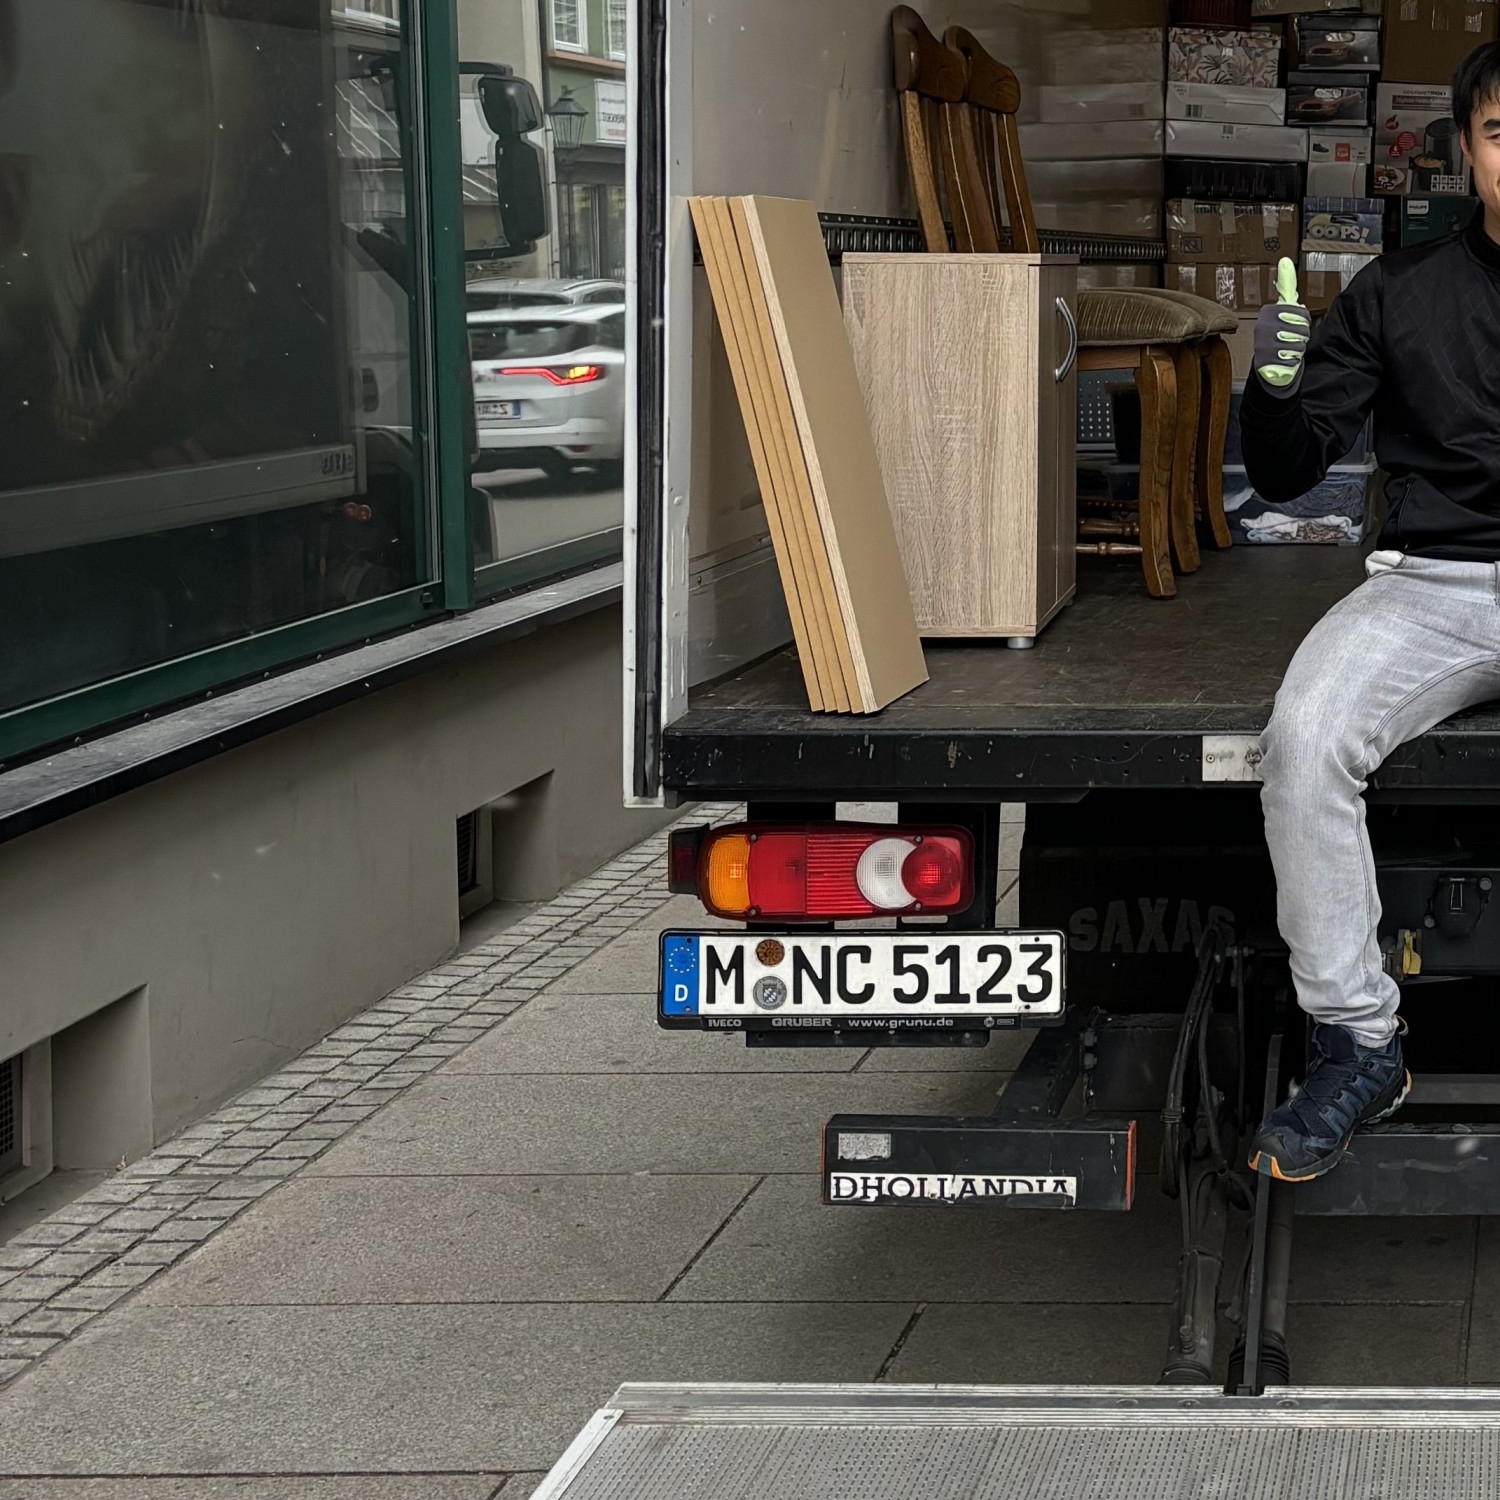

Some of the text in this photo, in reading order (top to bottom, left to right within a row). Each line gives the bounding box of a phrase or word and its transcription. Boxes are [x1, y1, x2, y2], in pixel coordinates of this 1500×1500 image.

[1068, 896, 1236, 953] SAXAS
[705, 943, 1054, 1005] M NC 5123
[674, 985, 689, 1002] D
[708, 1017, 955, 1029] IVECO GRUBER www.grunu.de
[832, 1175, 1071, 1200] DHOLLANDIA
